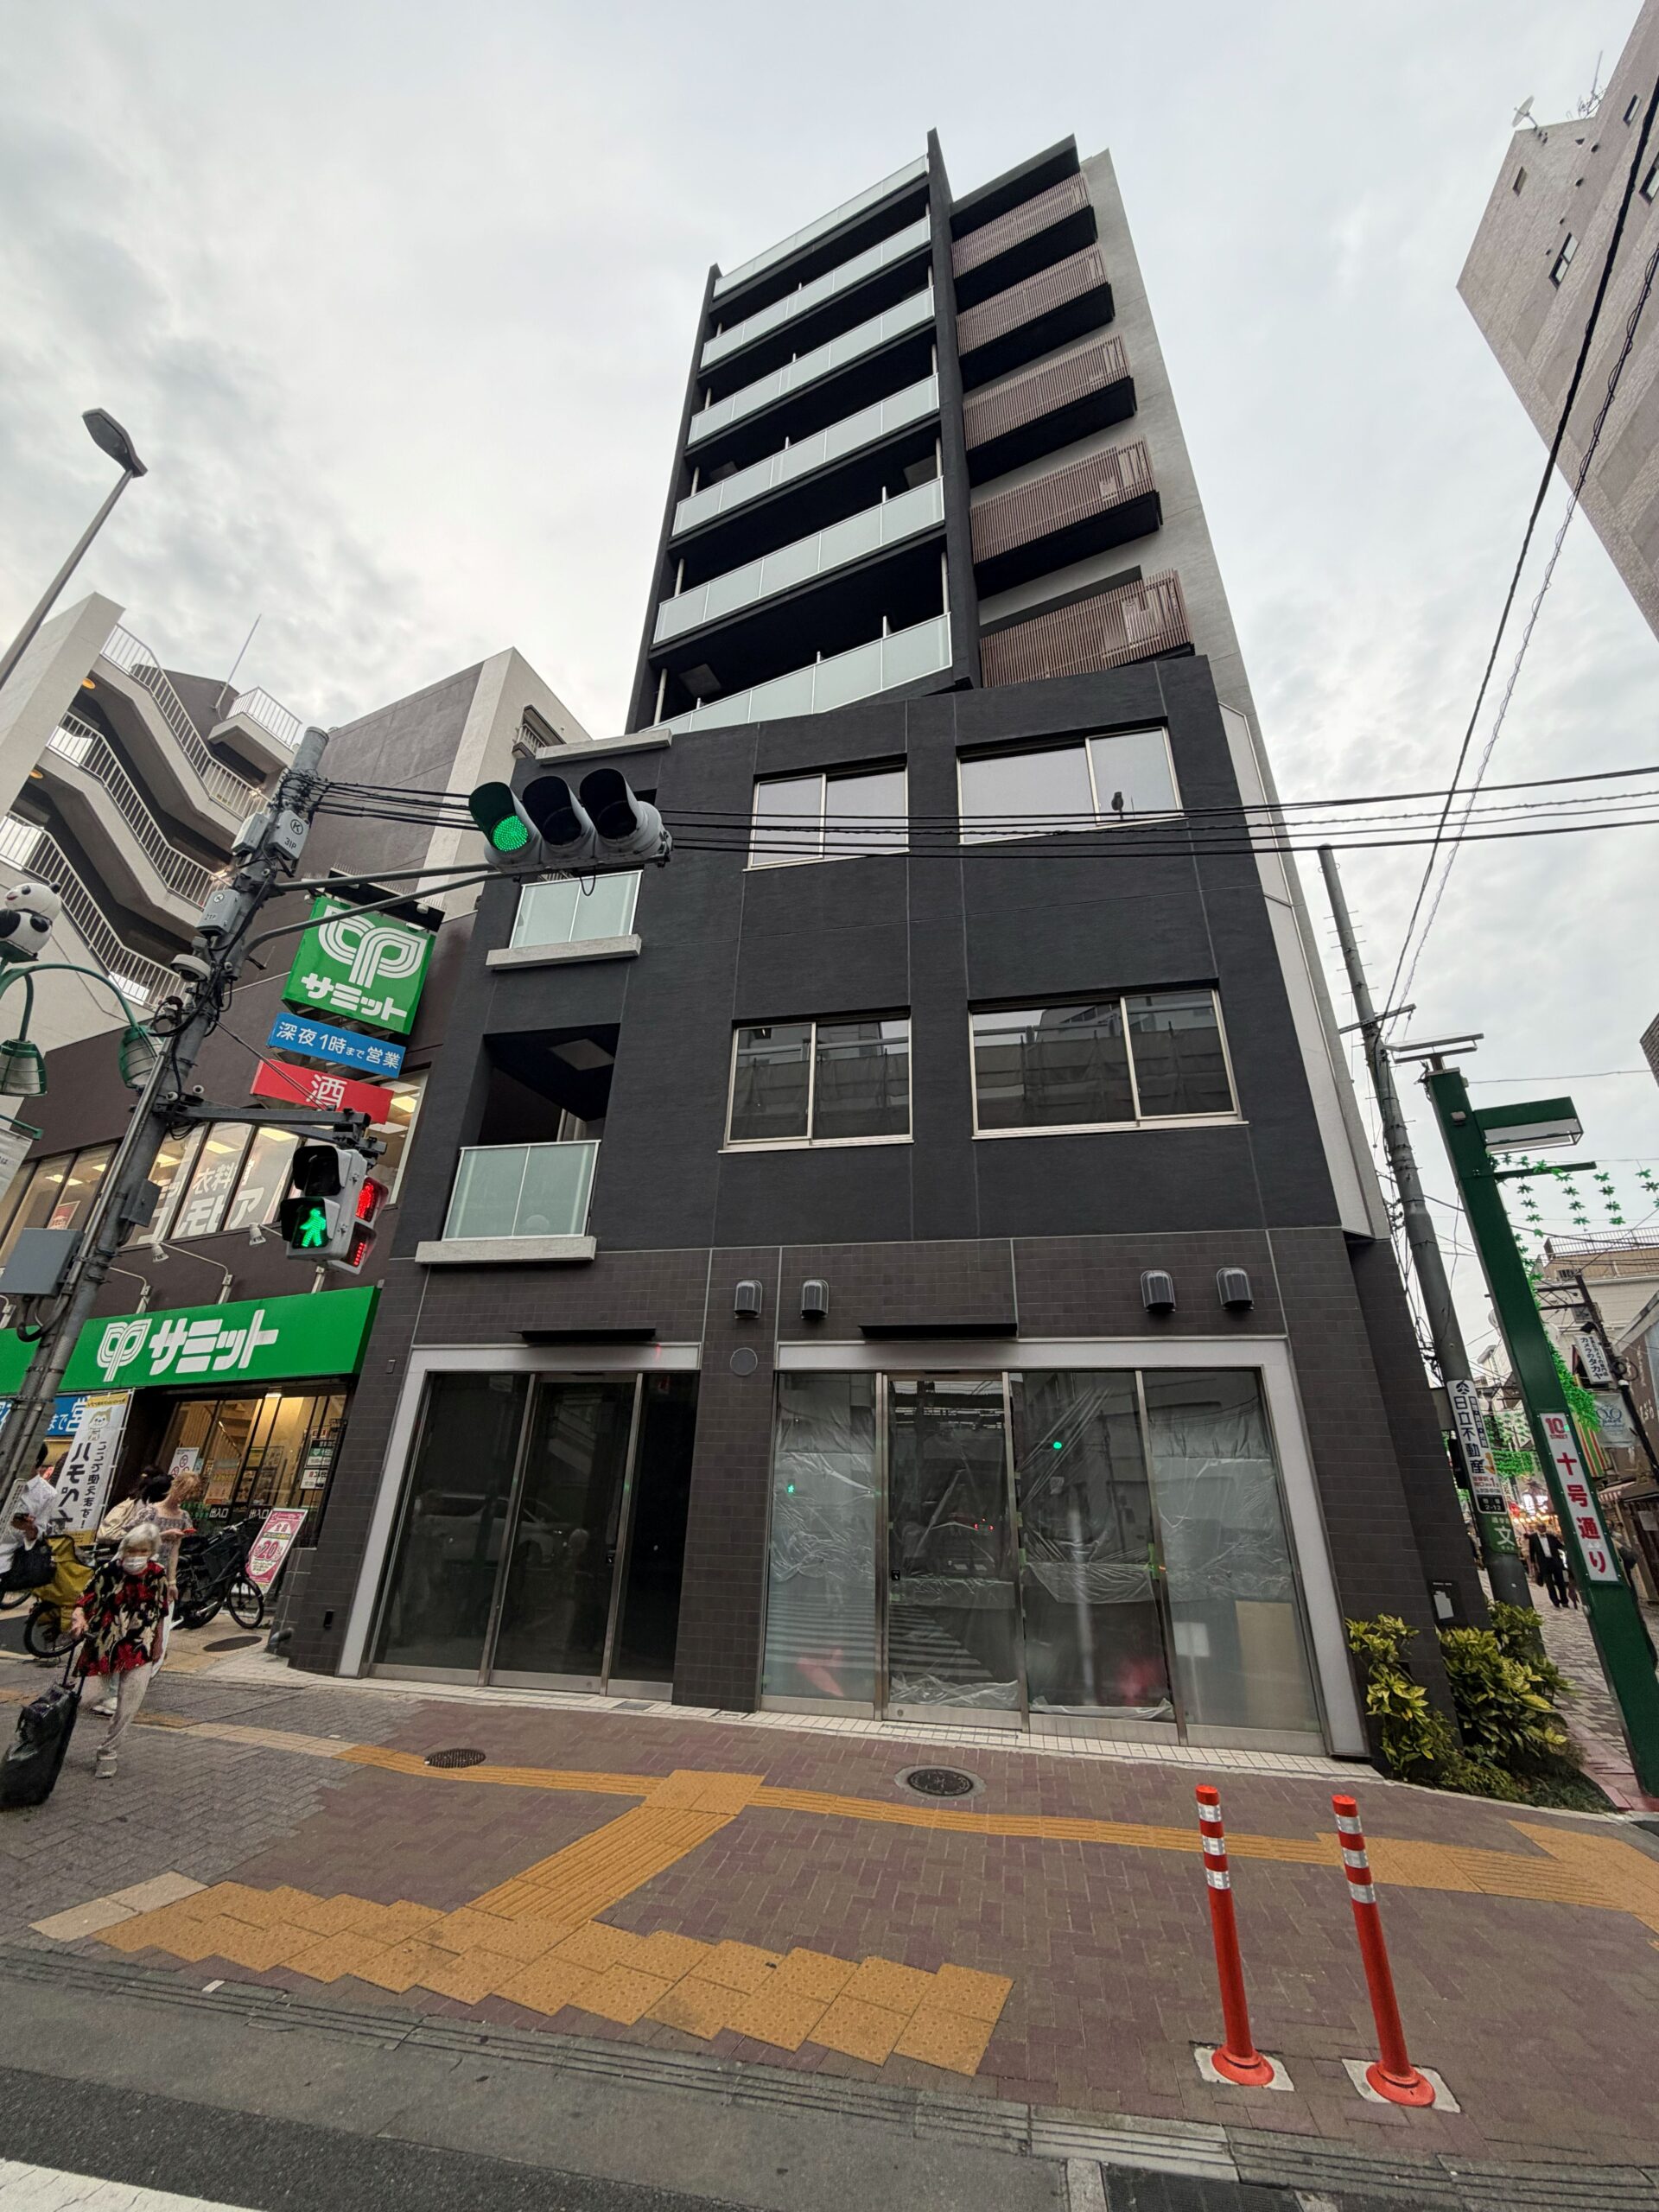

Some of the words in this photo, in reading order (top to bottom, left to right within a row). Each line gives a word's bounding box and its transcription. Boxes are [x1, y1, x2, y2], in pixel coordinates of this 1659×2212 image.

[301, 972, 408, 1021] サミット
[276, 1021, 401, 1070] 深夜1時まで営業
[306, 1074, 347, 1111] 酒
[149, 1309, 279, 1376] サミット
[1454, 1395, 1484, 1474] 日立不動産
[209, 1507, 229, 1519] 出入口
[1557, 1452, 1607, 1573] 十号通り
